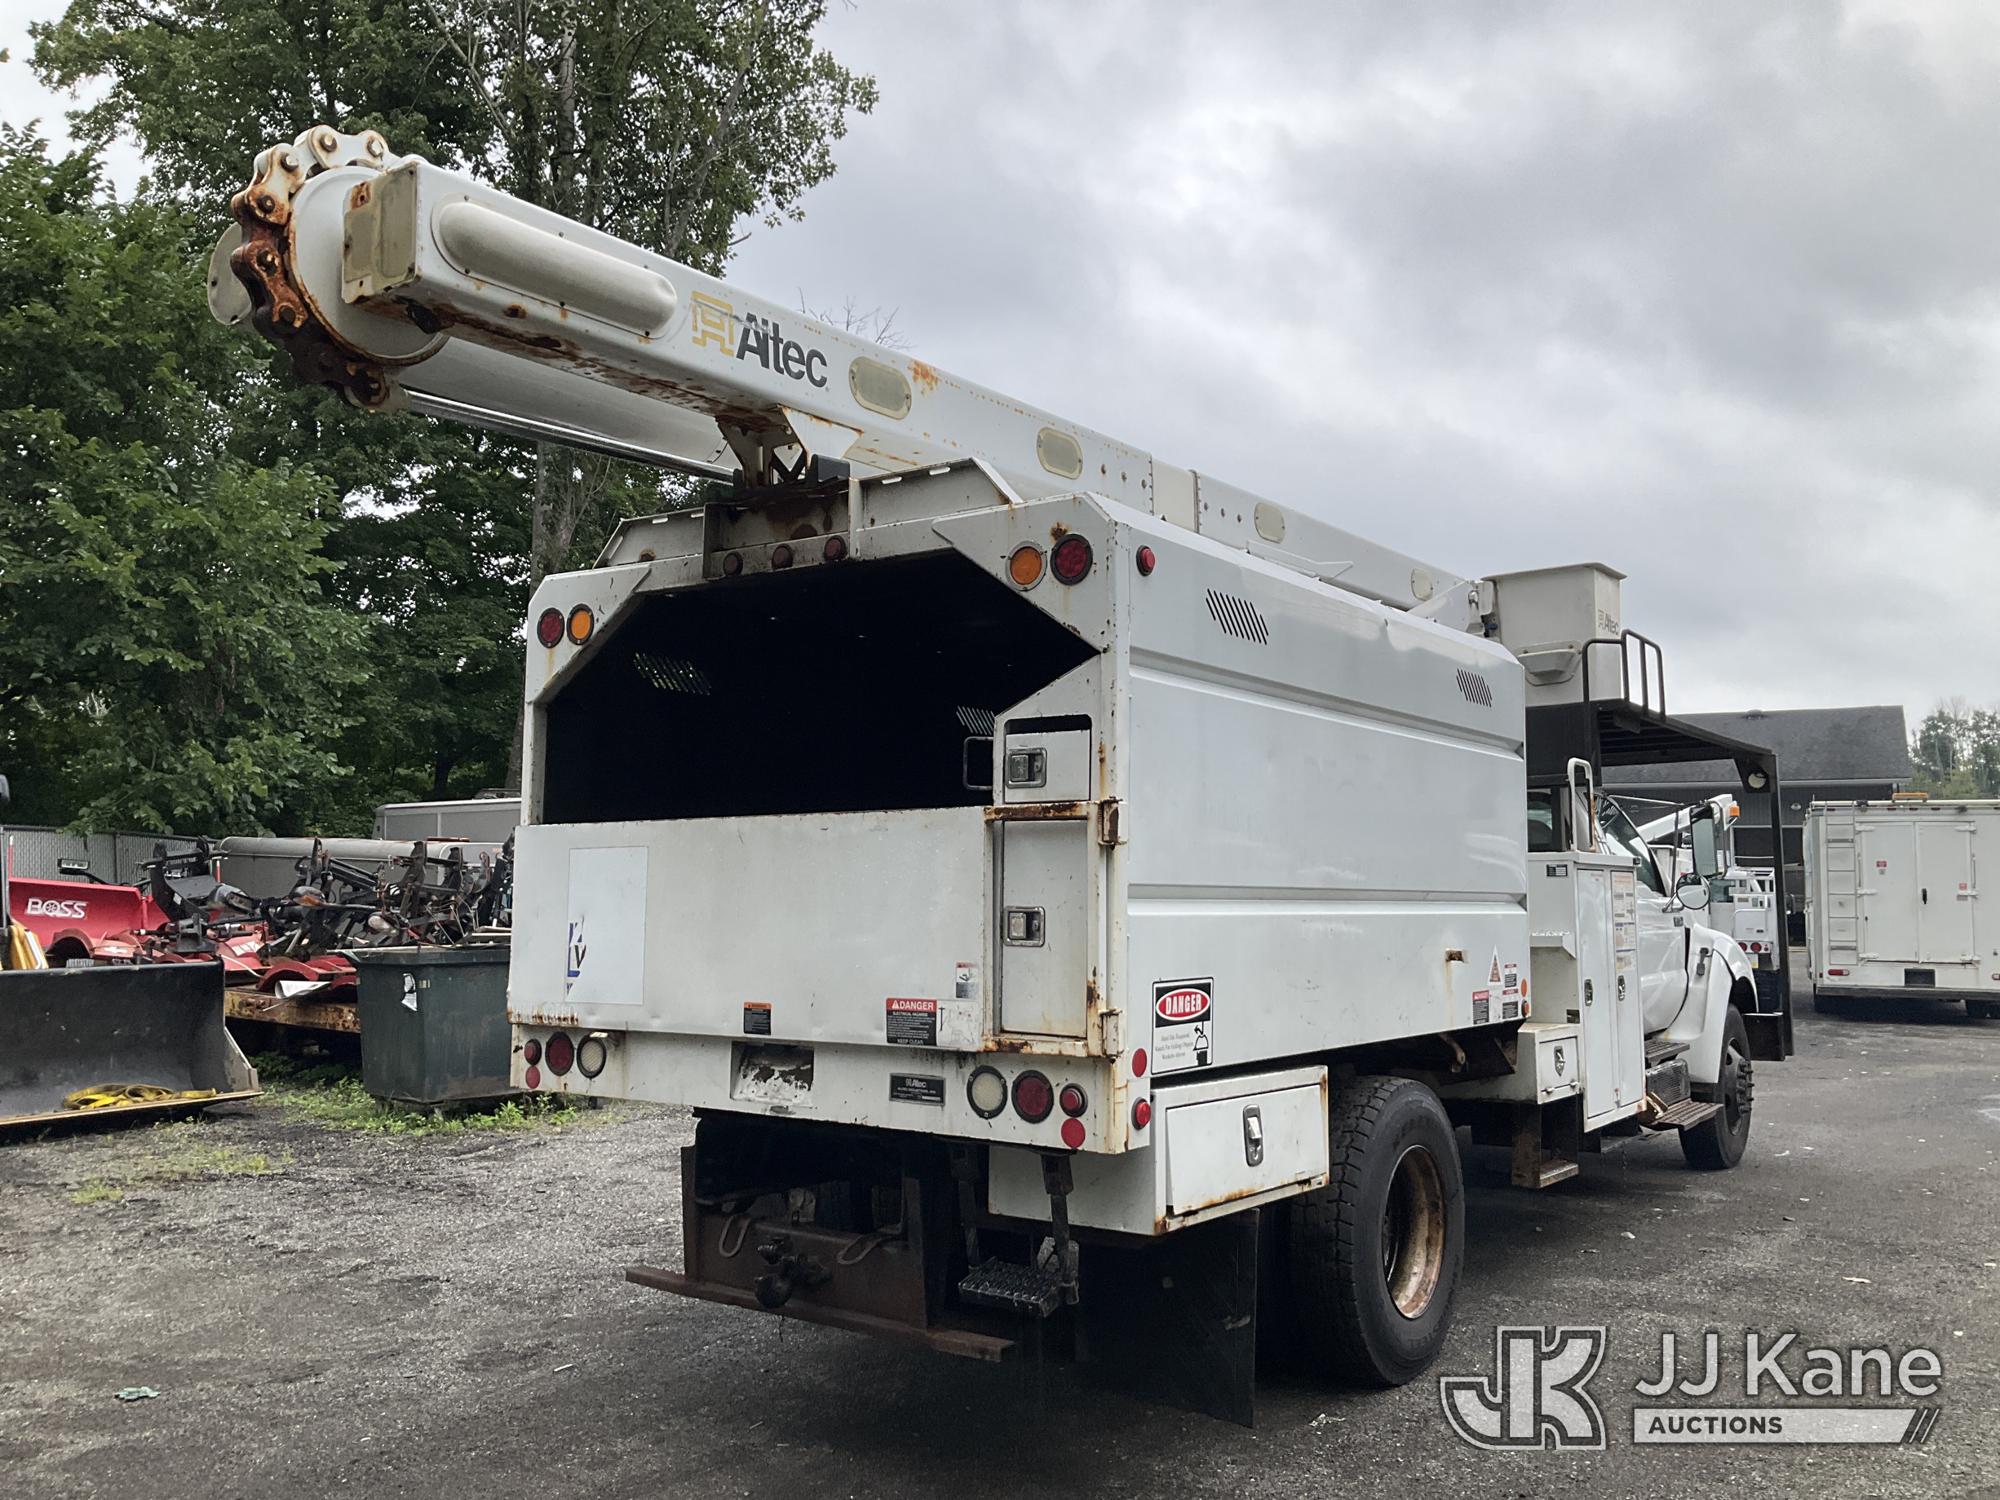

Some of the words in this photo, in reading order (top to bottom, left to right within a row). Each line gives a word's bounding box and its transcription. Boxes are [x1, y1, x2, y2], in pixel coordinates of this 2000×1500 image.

[736, 312, 828, 389] Altec
[26, 898, 88, 919] BOSS
[899, 1001, 934, 1010] DANGER
[1165, 993, 1202, 1016] DANGER
